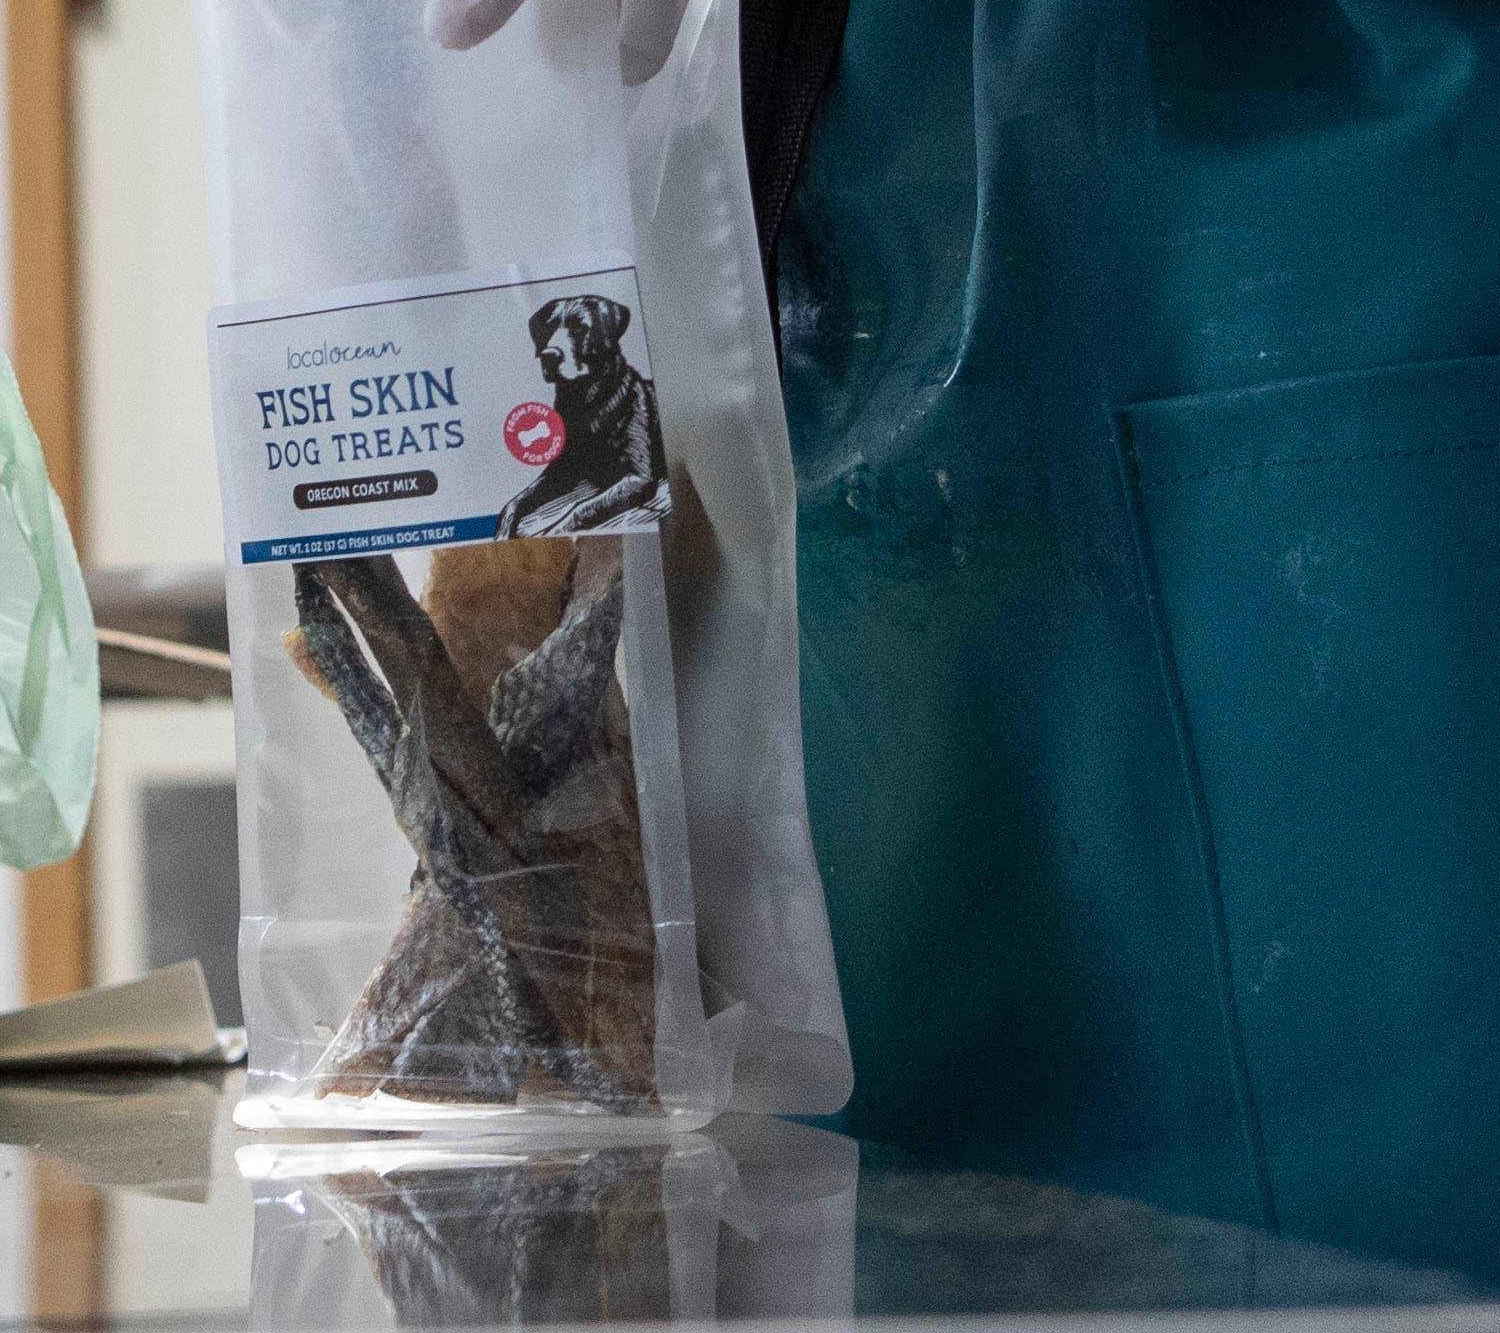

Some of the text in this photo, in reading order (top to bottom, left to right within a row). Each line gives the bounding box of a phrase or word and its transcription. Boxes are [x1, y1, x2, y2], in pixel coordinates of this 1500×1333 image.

[256, 366, 459, 430] FISH SKIN
[265, 419, 466, 471] DOG TREATS
[307, 477, 420, 502] OREGON COAST MIX
[271, 544, 288, 557] NET
[349, 536, 369, 549] FISH
[370, 534, 395, 547] SKIN
[396, 531, 421, 544] DOG
[422, 527, 456, 541] TREAT
